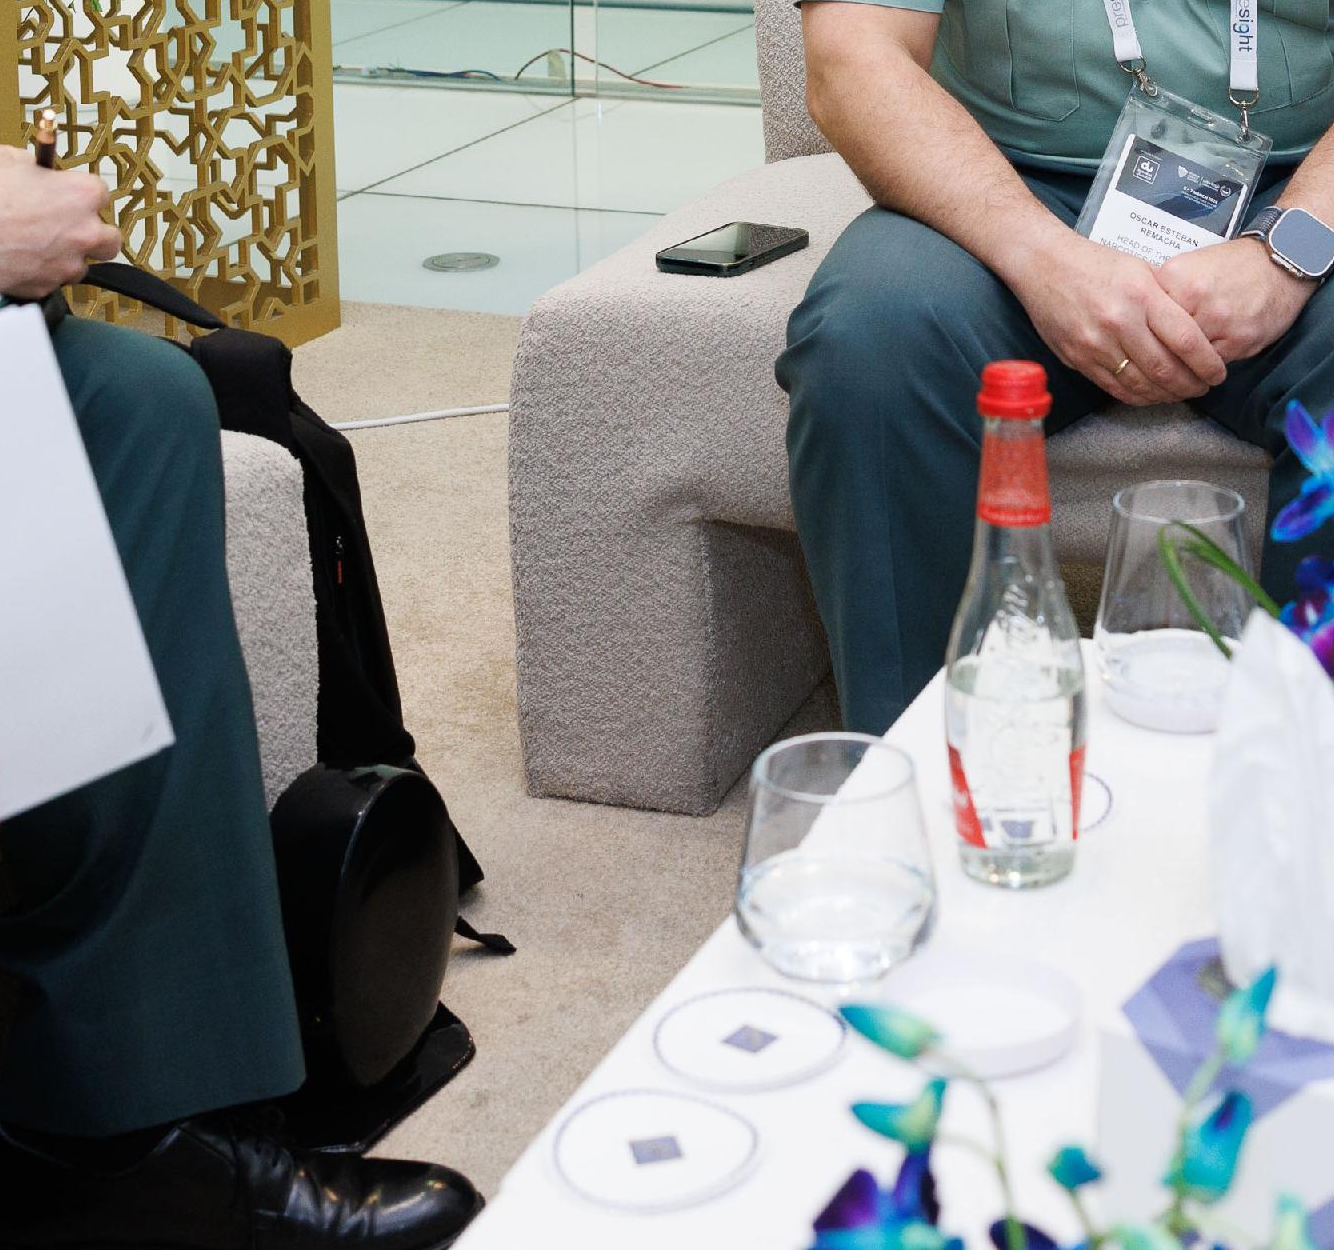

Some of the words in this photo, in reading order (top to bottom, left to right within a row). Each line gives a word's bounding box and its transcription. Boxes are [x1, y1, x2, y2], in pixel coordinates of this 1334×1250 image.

[1130, 212, 1158, 229] OSCAR
[1160, 225, 1199, 247] ESTEBAN
[1140, 228, 1181, 250] REMACHA
[1118, 234, 1141, 250] HEAD
[1141, 244, 1153, 254] OF
